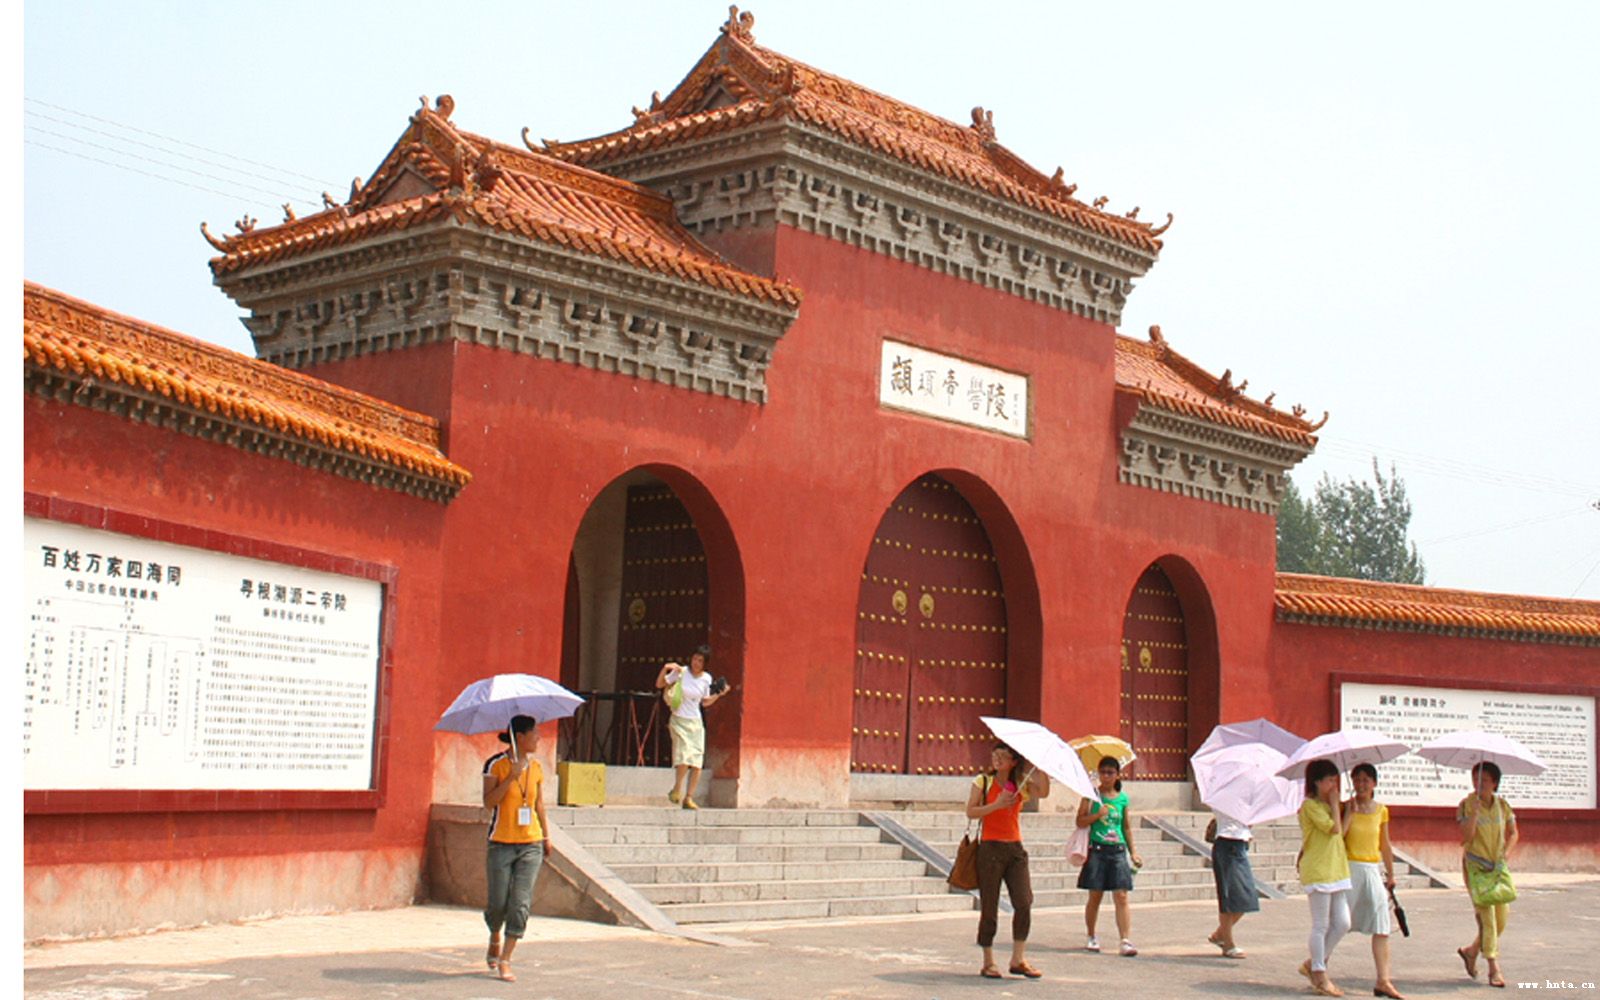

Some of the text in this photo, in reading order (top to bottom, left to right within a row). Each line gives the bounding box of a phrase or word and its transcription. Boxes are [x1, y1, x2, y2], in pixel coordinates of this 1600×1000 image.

[41, 545, 182, 586] 百姓万家四海同
[240, 578, 347, 612] 寻根溯源二帝陵
